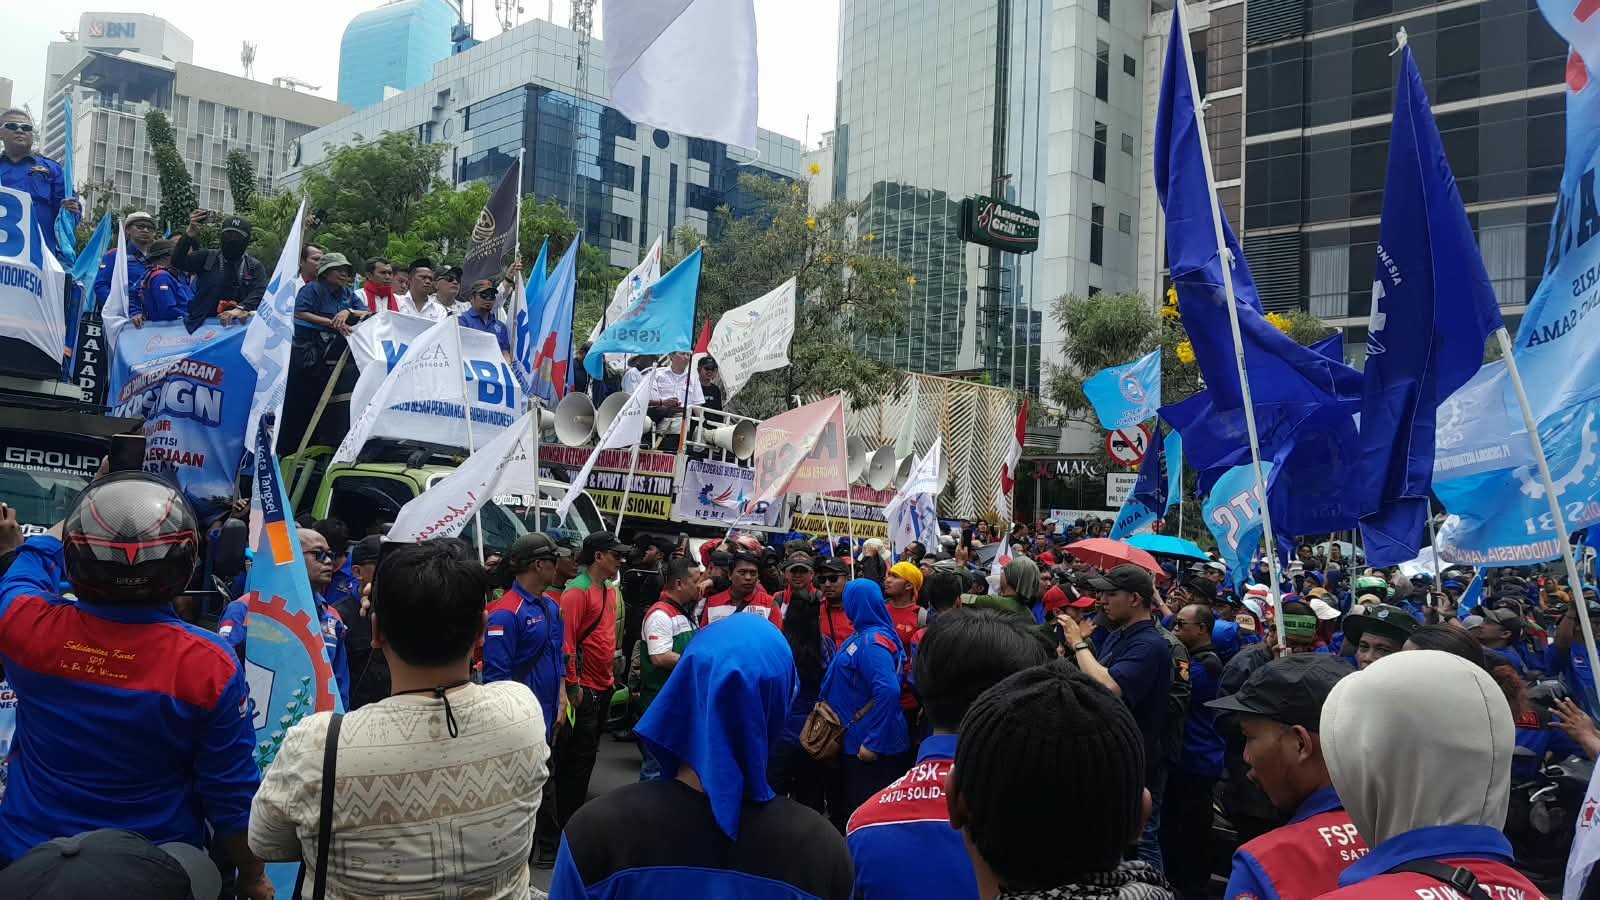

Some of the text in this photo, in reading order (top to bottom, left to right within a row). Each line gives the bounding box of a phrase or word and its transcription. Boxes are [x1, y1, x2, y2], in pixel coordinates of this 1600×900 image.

[106, 22, 136, 39] BNI
[994, 204, 1040, 228] American
[992, 218, 1017, 235] Grill
[3, 461, 51, 473] BUILDING
[5, 447, 101, 471] GROUP
[590, 474, 596, 488] &
[261, 472, 279, 514] Tangsel
[1317, 823, 1358, 847] FSP
